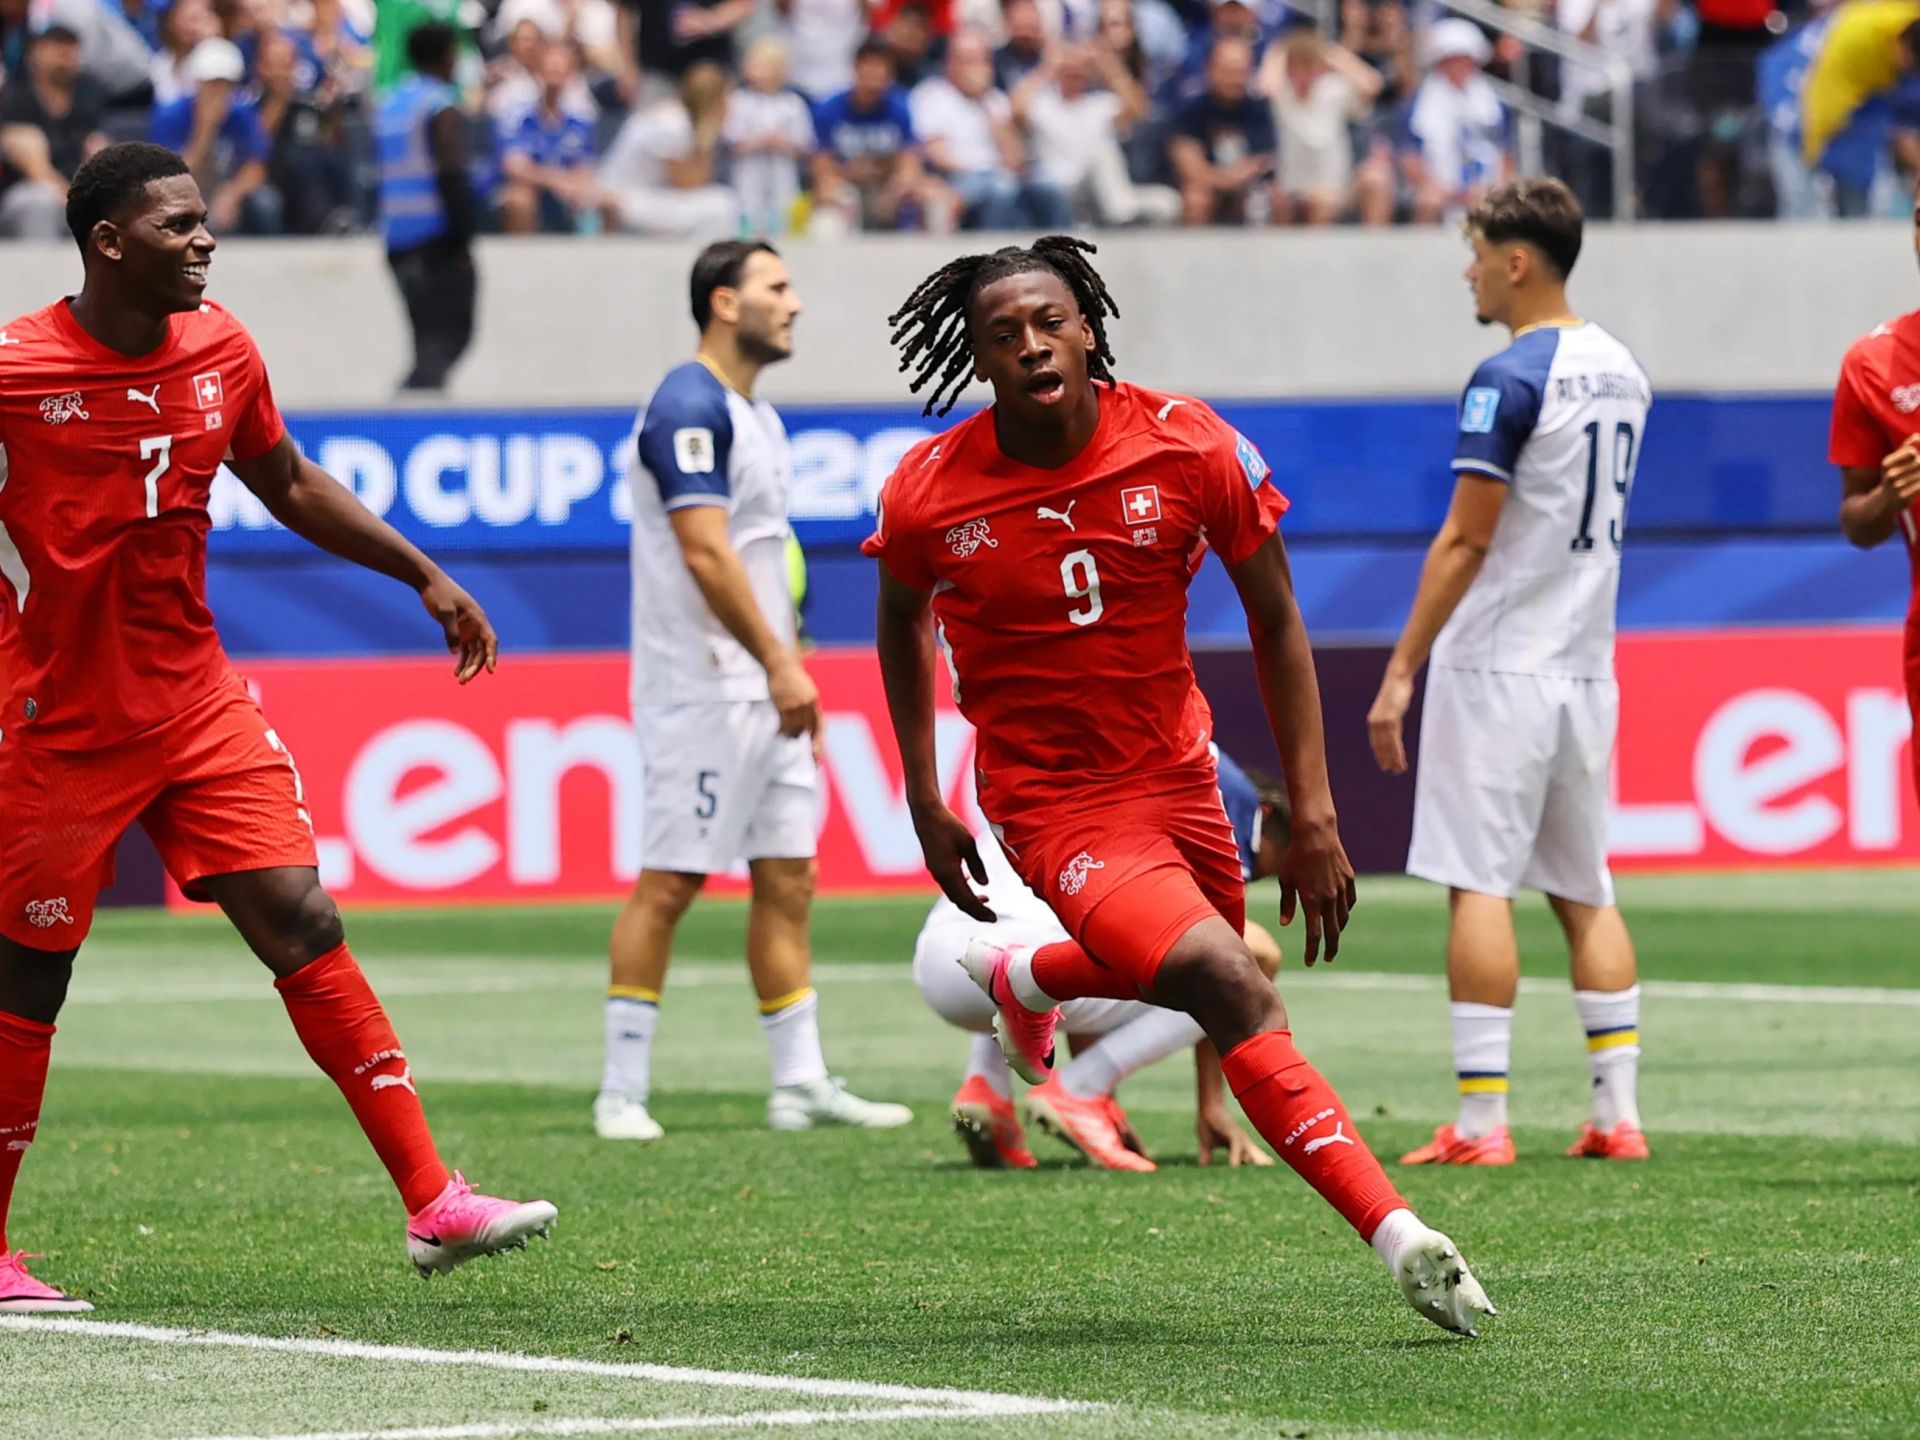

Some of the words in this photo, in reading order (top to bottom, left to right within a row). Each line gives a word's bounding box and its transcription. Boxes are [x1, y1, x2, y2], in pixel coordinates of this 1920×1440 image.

[139, 434, 173, 518] 7
[404, 433, 603, 528] CUP
[1570, 420, 1634, 551] 19
[1060, 548, 1104, 626] 9
[696, 769, 720, 819] 5
[1284, 1107, 1336, 1146] suisse
